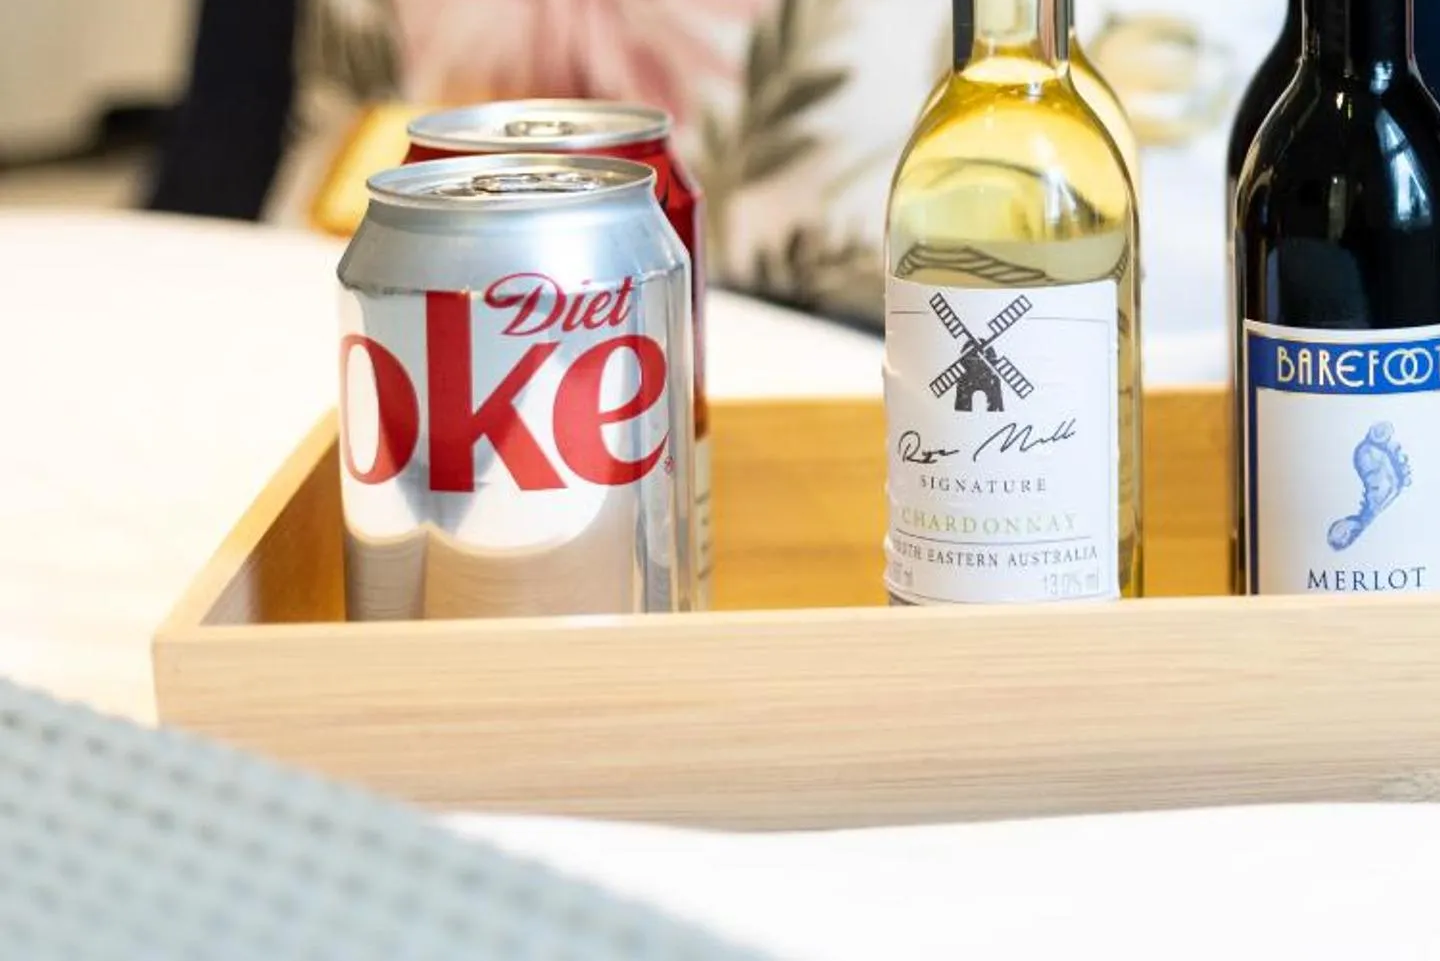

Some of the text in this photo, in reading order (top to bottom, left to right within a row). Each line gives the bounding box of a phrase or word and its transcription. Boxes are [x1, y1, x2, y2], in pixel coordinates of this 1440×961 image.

[484, 272, 635, 336] Diet
[340, 290, 671, 492] oke
[920, 474, 1046, 494] SIGNATURE
[901, 508, 1078, 536] CHARDONNAY
[927, 547, 998, 567] EASTERN
[1008, 545, 1098, 567] AUSTRALIA
[1307, 566, 1426, 592] MERLOT
